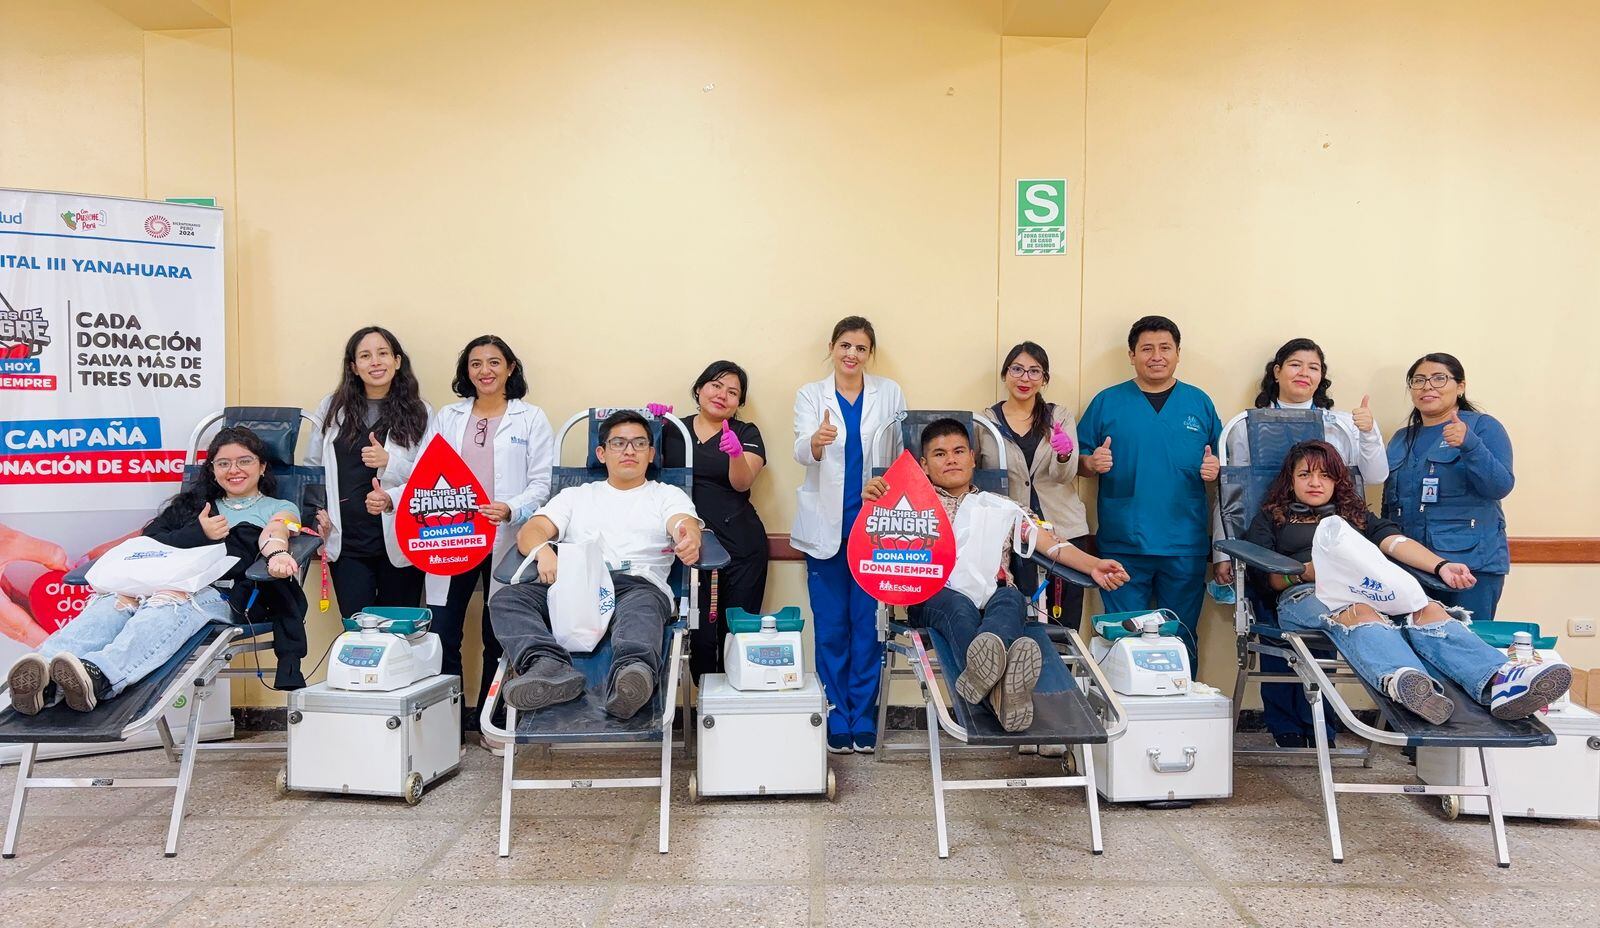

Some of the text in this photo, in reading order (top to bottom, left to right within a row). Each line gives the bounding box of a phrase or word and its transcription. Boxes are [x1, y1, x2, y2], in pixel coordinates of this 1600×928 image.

[1024, 184, 1059, 224] S
[47, 257, 66, 271] III
[72, 259, 192, 279] YANAHUARA
[22, 308, 43, 320] DE
[76, 312, 141, 330] CADA
[77, 331, 201, 352] DONACIÓN
[4, 362, 36, 372] HOY,
[77, 352, 201, 369] SALVA MÁS DE
[78, 371, 201, 388] TRES VIDAS
[5, 421, 147, 449] CAMPAÑA
[0, 455, 205, 475] NACIÓN DE SANG
[414, 485, 474, 498] HINCHAS DE
[409, 494, 479, 514] SANGRE
[873, 506, 936, 519] HINCHAS DE
[450, 526, 472, 534] HOY,
[866, 516, 941, 537] SANGRE
[411, 537, 483, 549] DONA SIEMPRE
[906, 553, 928, 562] HOY,
[862, 563, 939, 575] DONA SIEMPRE
[893, 584, 922, 593] EsSalud
